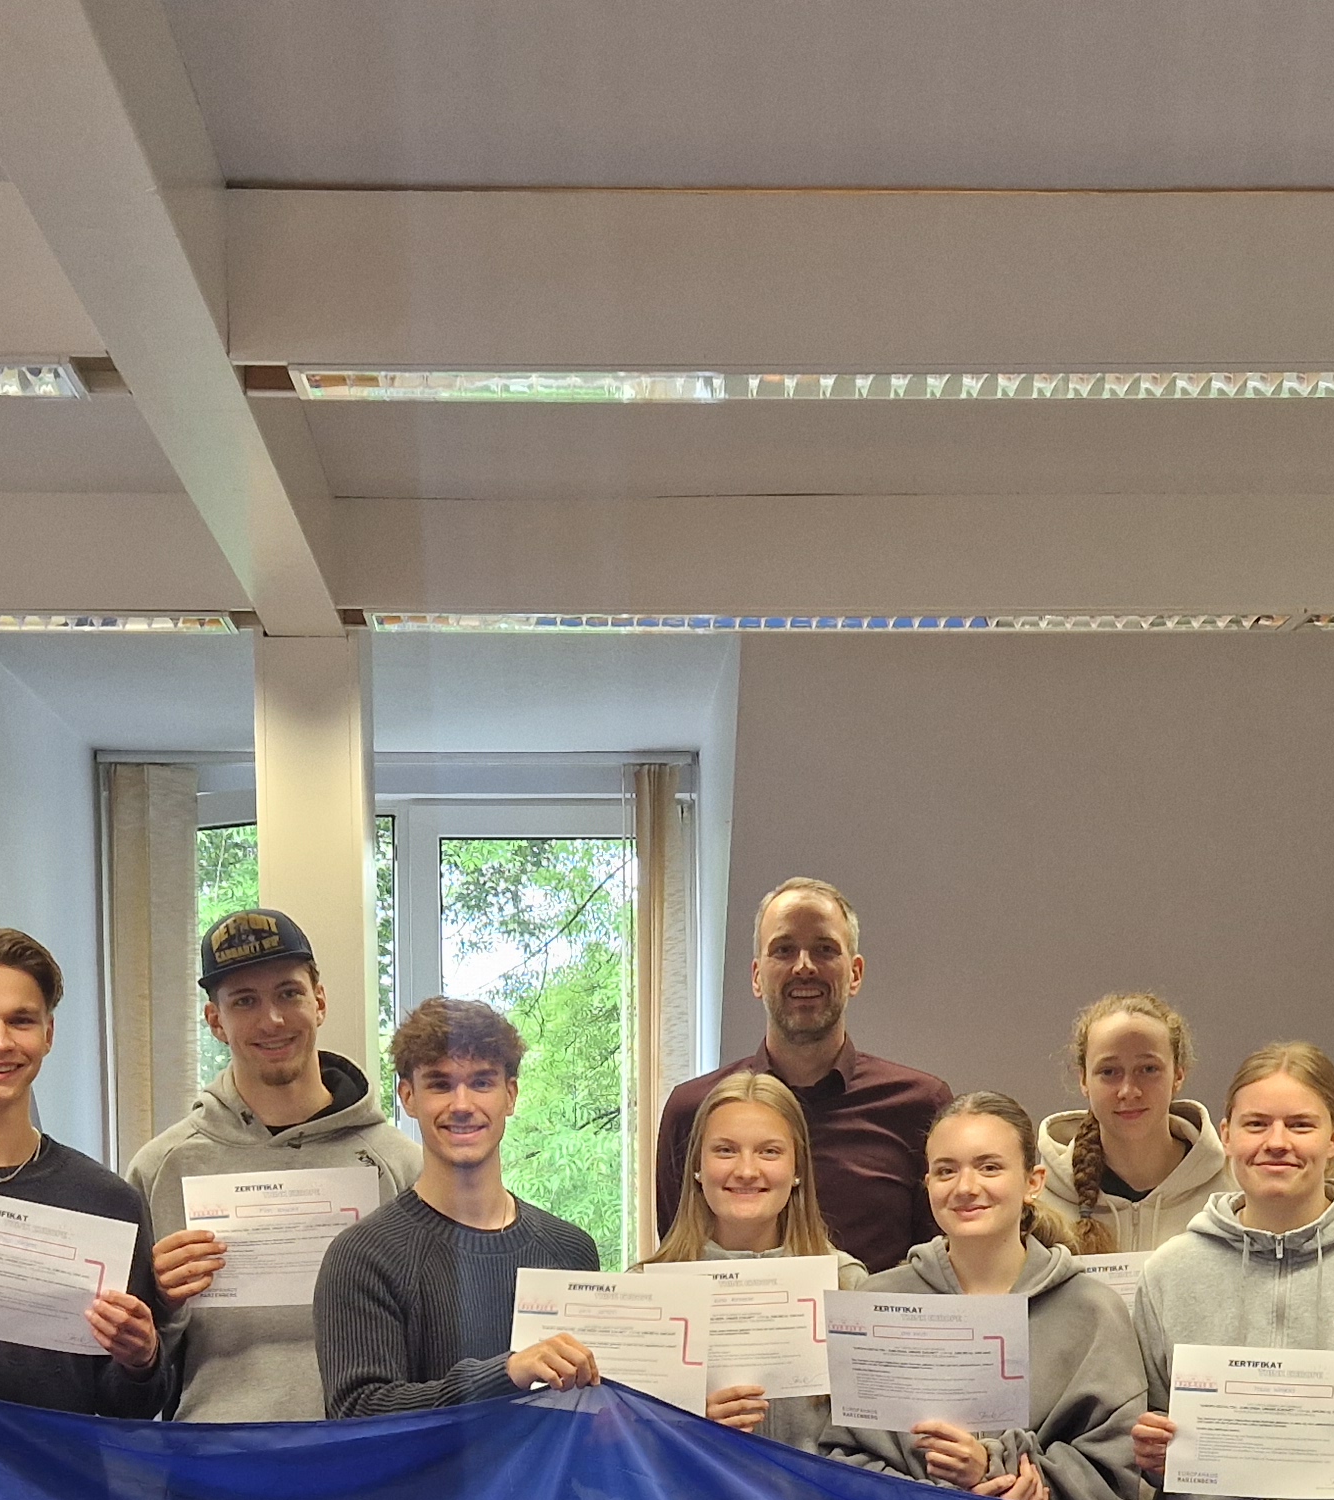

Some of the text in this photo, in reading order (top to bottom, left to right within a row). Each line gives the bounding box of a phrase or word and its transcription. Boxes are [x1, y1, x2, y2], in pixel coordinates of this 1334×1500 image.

[234, 1183, 284, 1193] ZERTIFIKAT
[567, 1283, 617, 1292] ZERTIFIKAT
[873, 1304, 923, 1314] ZERTIFIKAT
[1228, 1359, 1283, 1369] ZERTIFIKAT
